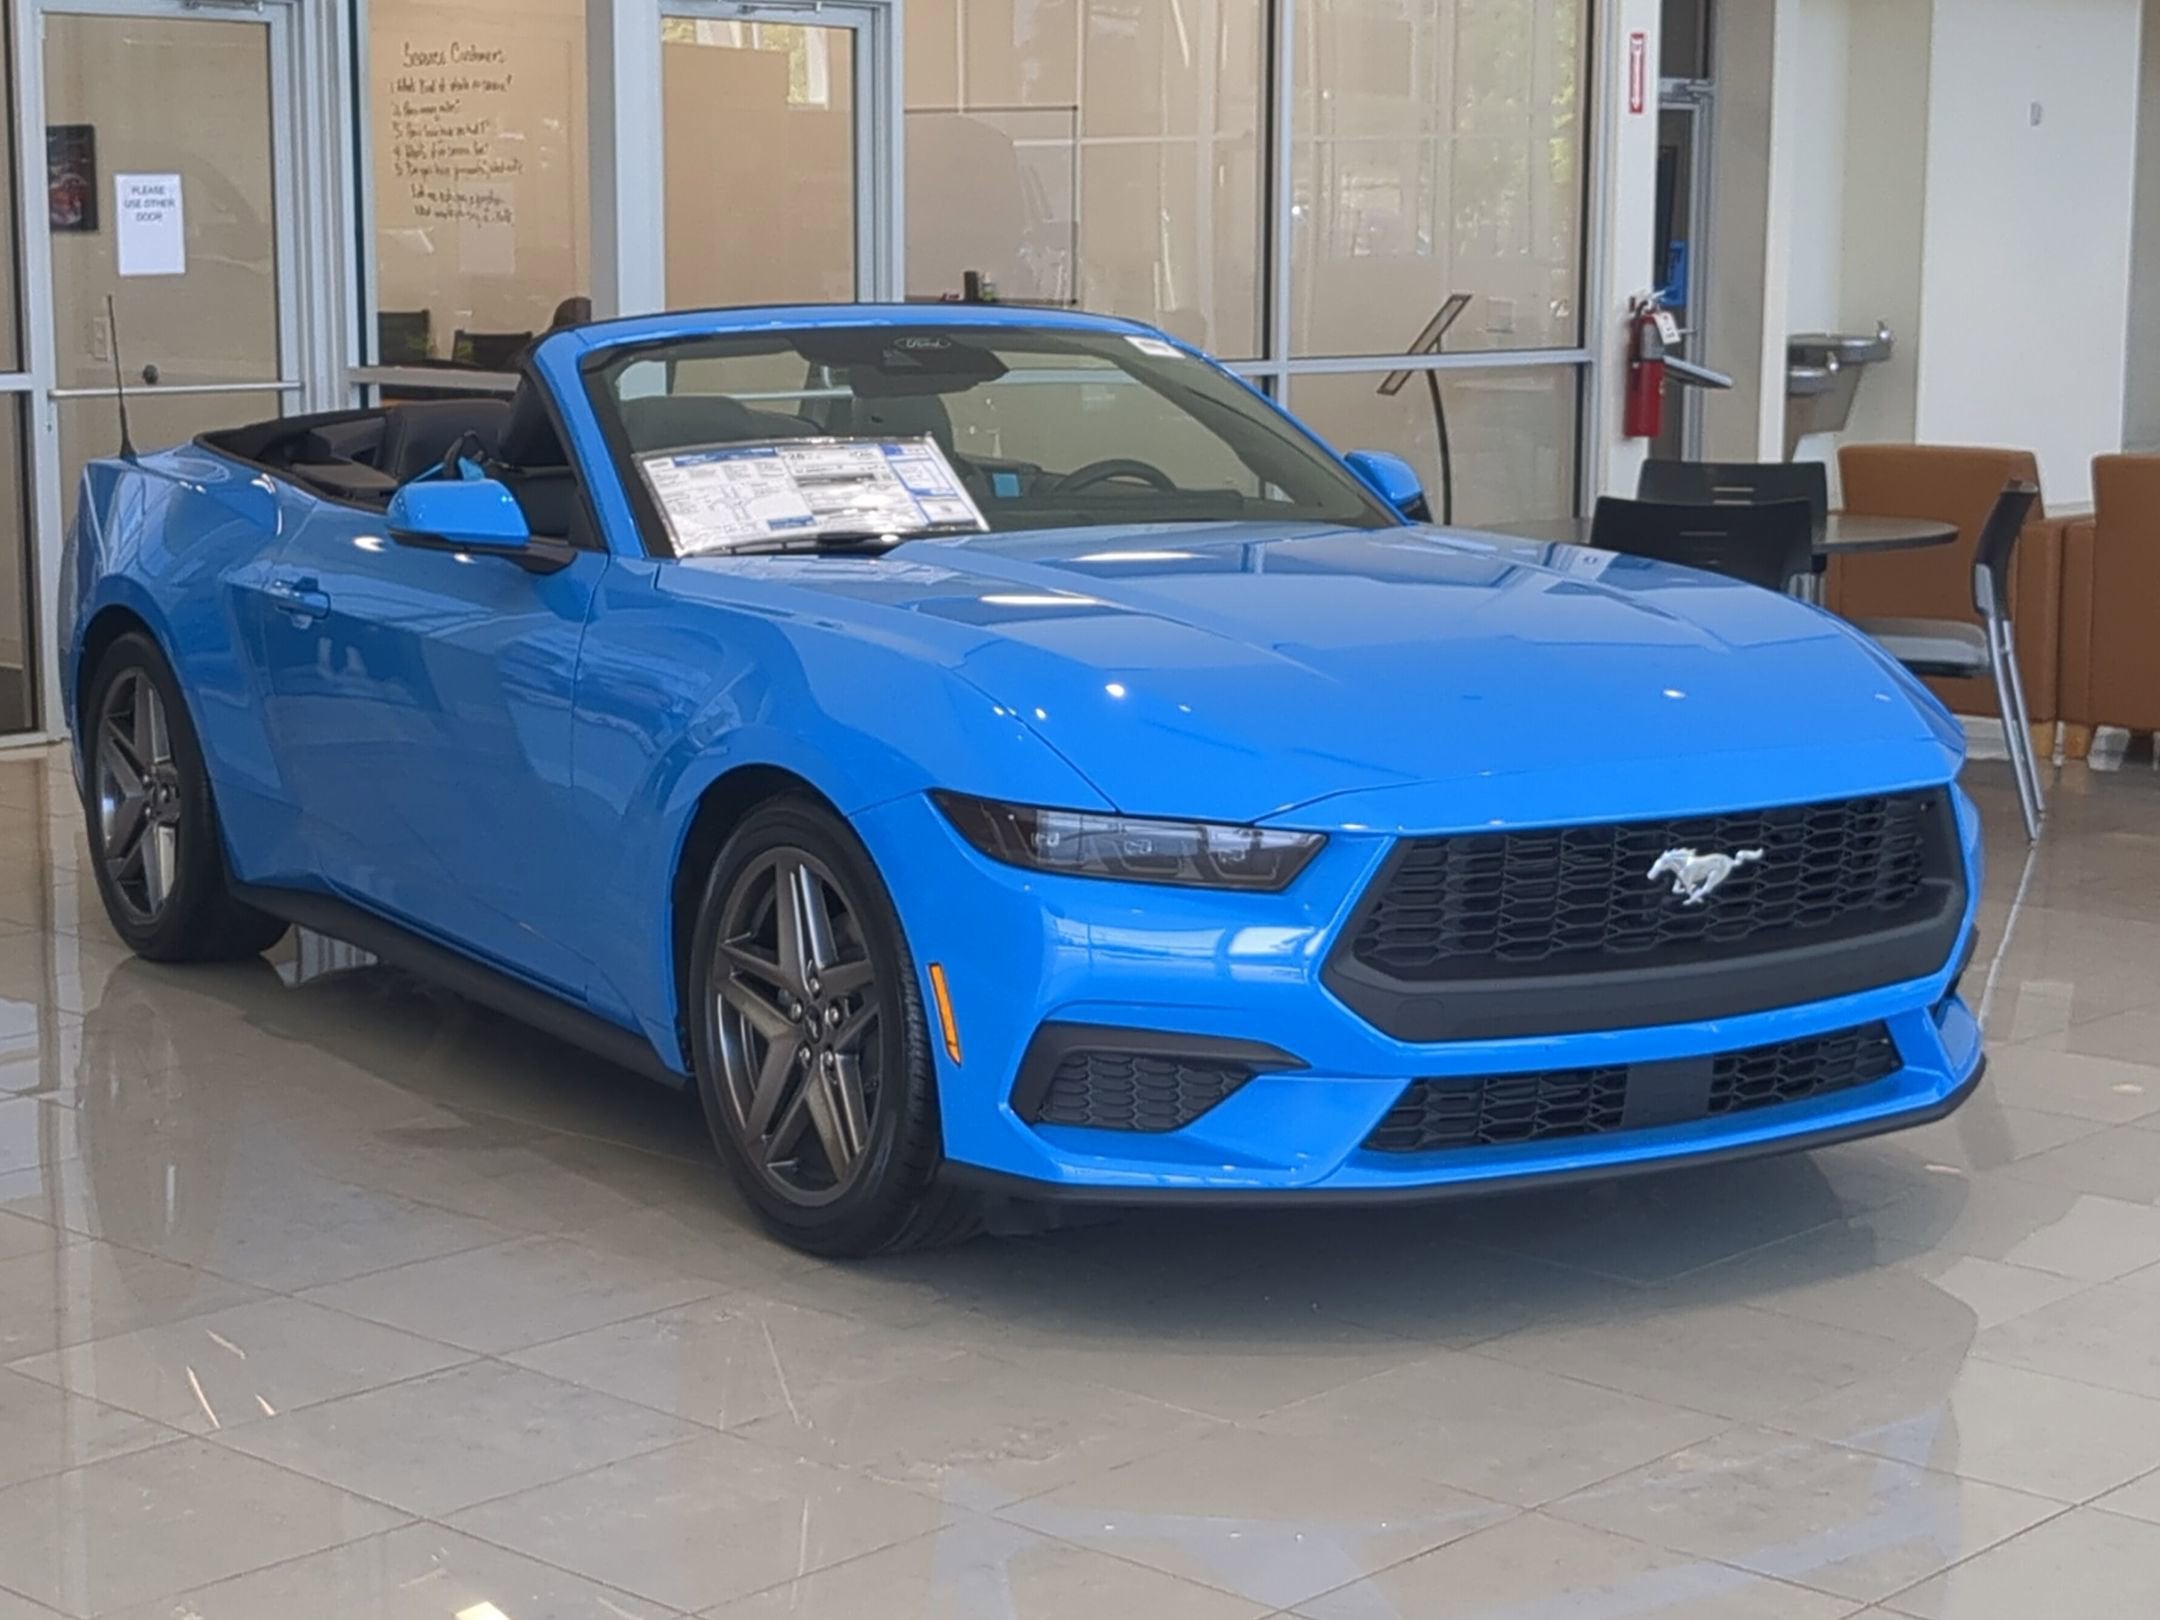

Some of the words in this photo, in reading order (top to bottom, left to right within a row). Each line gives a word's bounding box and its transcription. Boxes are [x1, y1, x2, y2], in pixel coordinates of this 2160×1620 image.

[131, 185, 165, 196] PLEASE
[124, 198, 142, 209] USE
[143, 198, 176, 209] OTHER
[136, 211, 163, 222] DOOR
[903, 337, 942, 349] Ford
